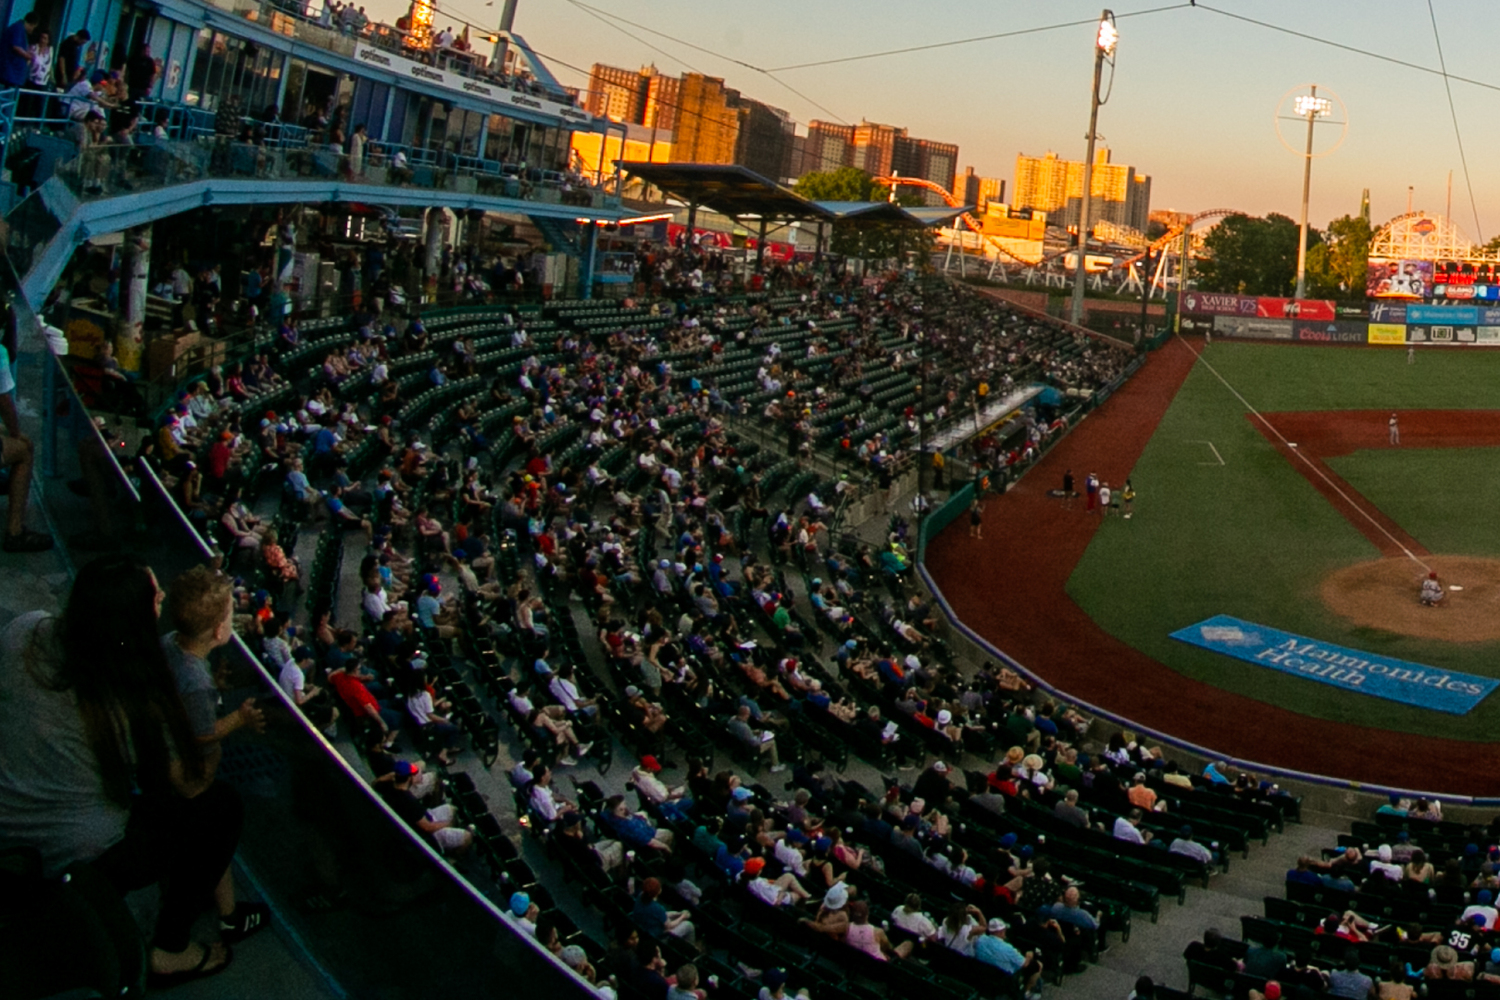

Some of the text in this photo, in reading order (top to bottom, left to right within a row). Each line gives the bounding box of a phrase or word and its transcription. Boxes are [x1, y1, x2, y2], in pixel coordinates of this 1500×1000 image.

[360, 49, 391, 66] optimum.
[411, 65, 444, 83] optimum.
[463, 81, 492, 96] optimum.
[511, 94, 542, 109] optimum.
[1201, 295, 1238, 307] XAVIER
[1300, 327, 1330, 341] Coors
[1332, 332, 1362, 341] LIGHT
[1255, 647, 1366, 686] Health
[1277, 639, 1485, 695] Maimonides
[1448, 930, 1472, 949] 35
